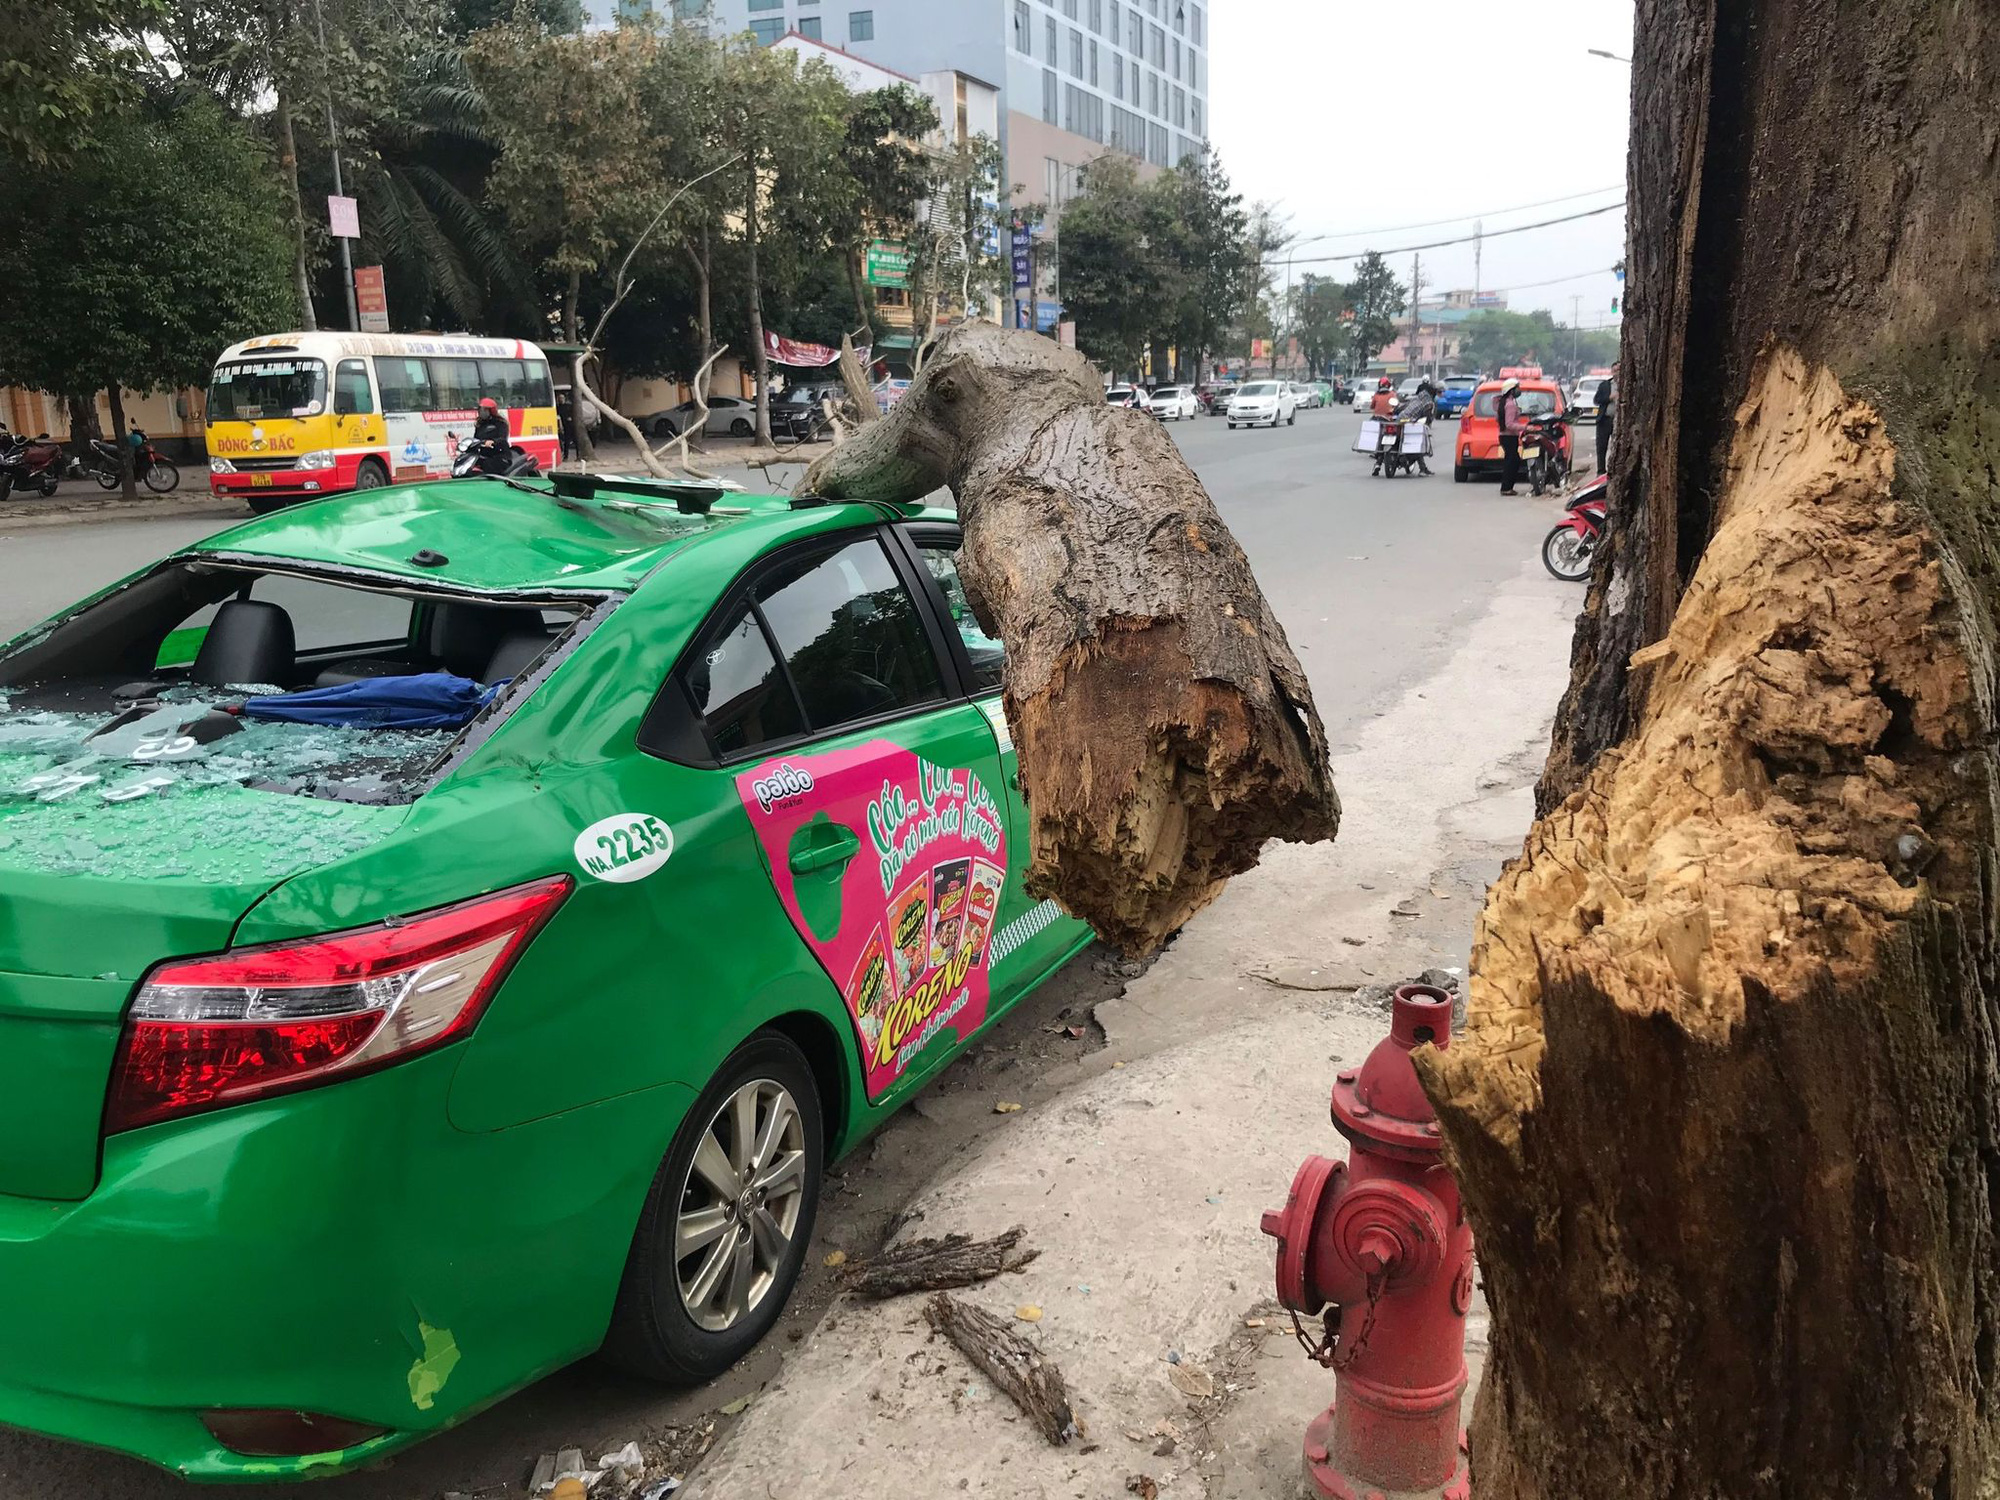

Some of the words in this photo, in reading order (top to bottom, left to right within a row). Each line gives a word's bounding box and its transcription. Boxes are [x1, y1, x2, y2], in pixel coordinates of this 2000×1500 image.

[752, 763, 814, 814] paldo
[903, 823, 918, 863] có
[961, 802, 1000, 855] Koreno
[869, 941, 973, 1075] KORENO
